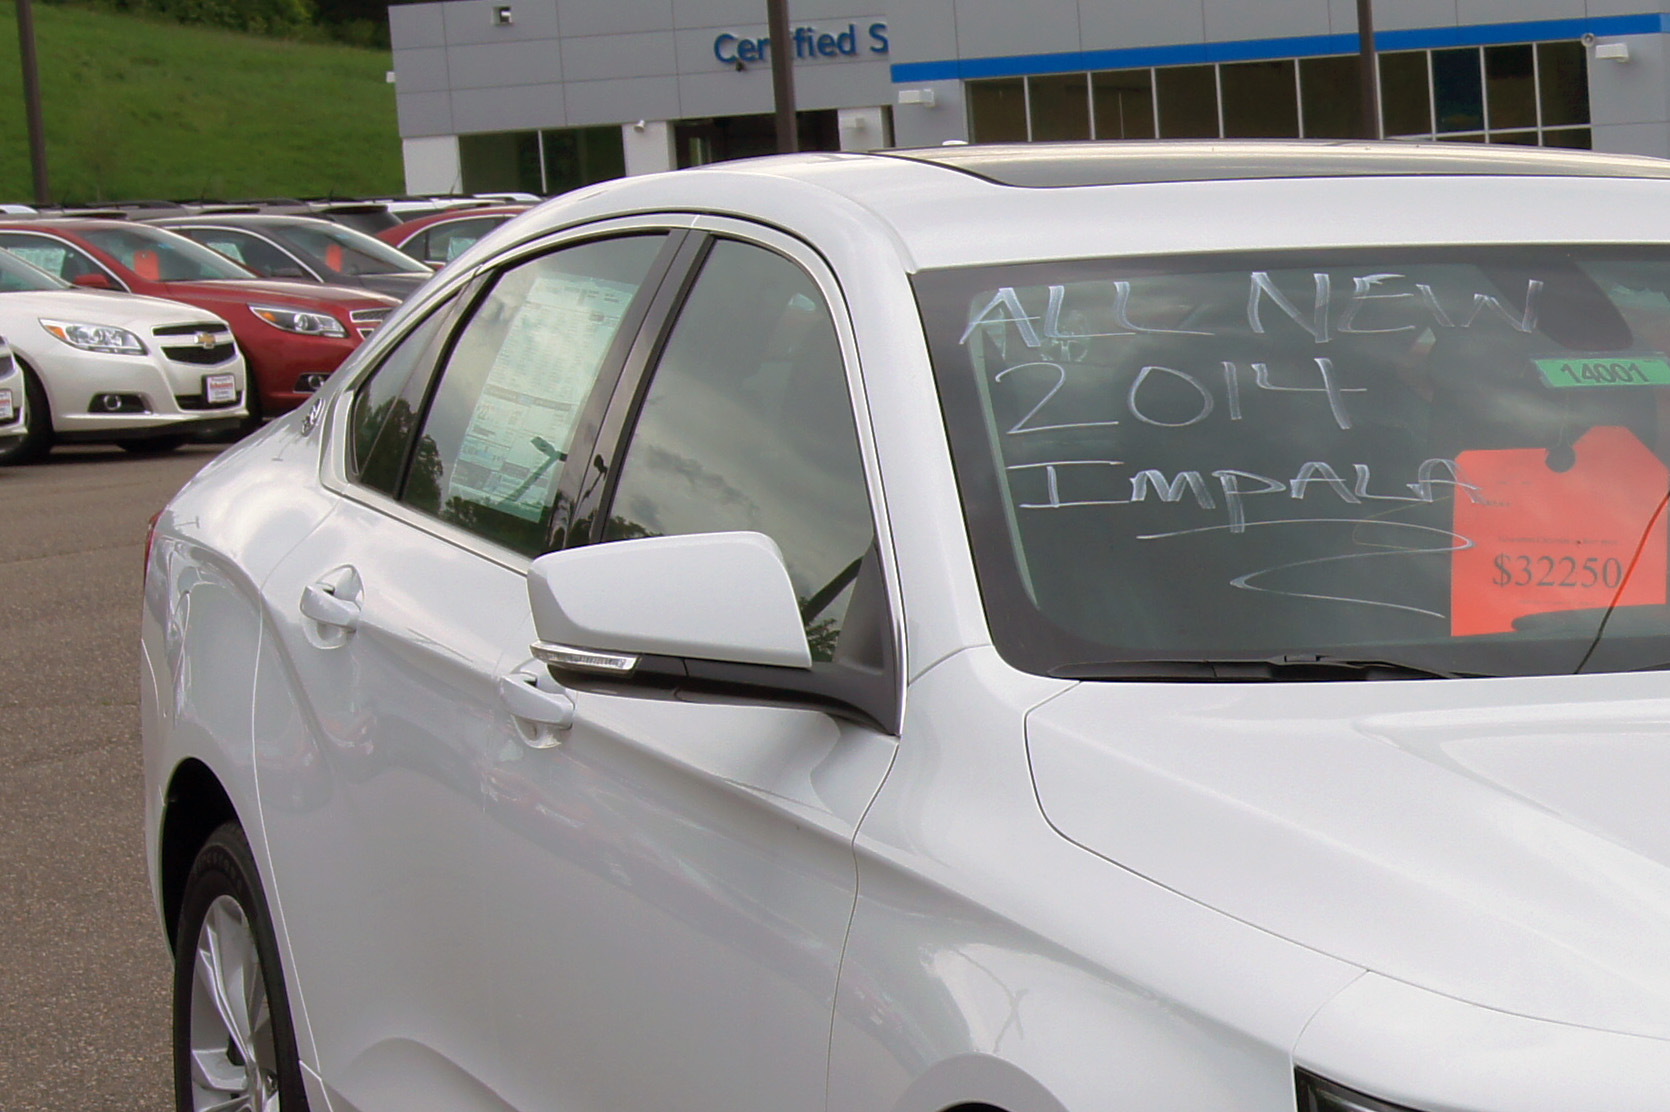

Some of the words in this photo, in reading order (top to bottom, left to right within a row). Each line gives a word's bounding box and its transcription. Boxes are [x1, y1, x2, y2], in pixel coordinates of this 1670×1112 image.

[714, 23, 856, 63] Cerfied
[959, 281, 1215, 347] ALL
[1247, 272, 1544, 343] NEW
[1560, 362, 1650, 384] 14001
[995, 357, 1367, 434] 2014
[1492, 553, 1623, 589] $32250
